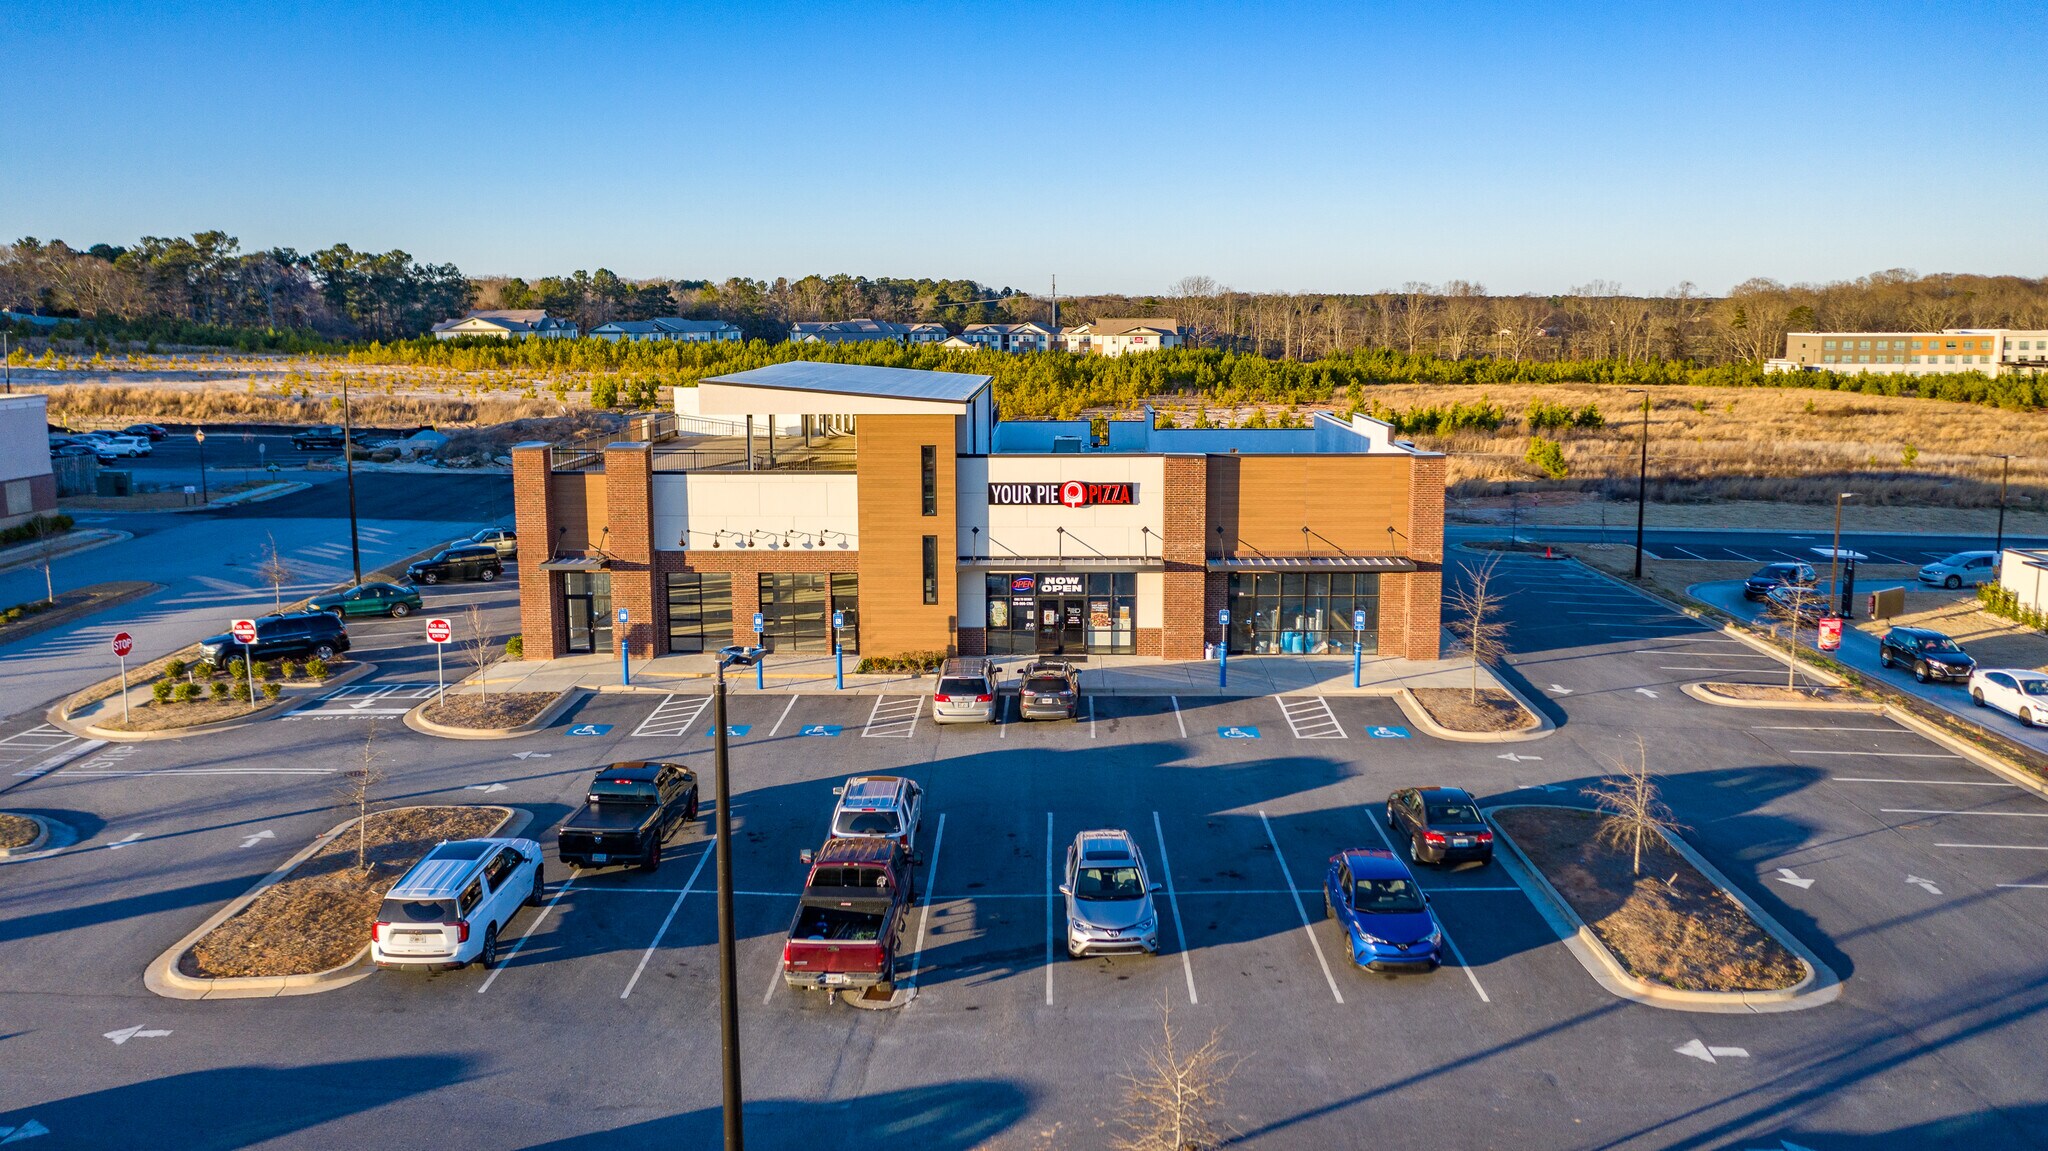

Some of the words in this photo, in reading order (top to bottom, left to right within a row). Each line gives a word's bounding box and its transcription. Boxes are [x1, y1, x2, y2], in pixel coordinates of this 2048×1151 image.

[992, 485, 1032, 504] YOUR
[1037, 485, 1058, 504] PIE
[1089, 485, 1130, 504] PIZZA
[1012, 580, 1034, 588] OPEN
[1045, 577, 1079, 585] NOW
[114, 637, 132, 651] STOP
